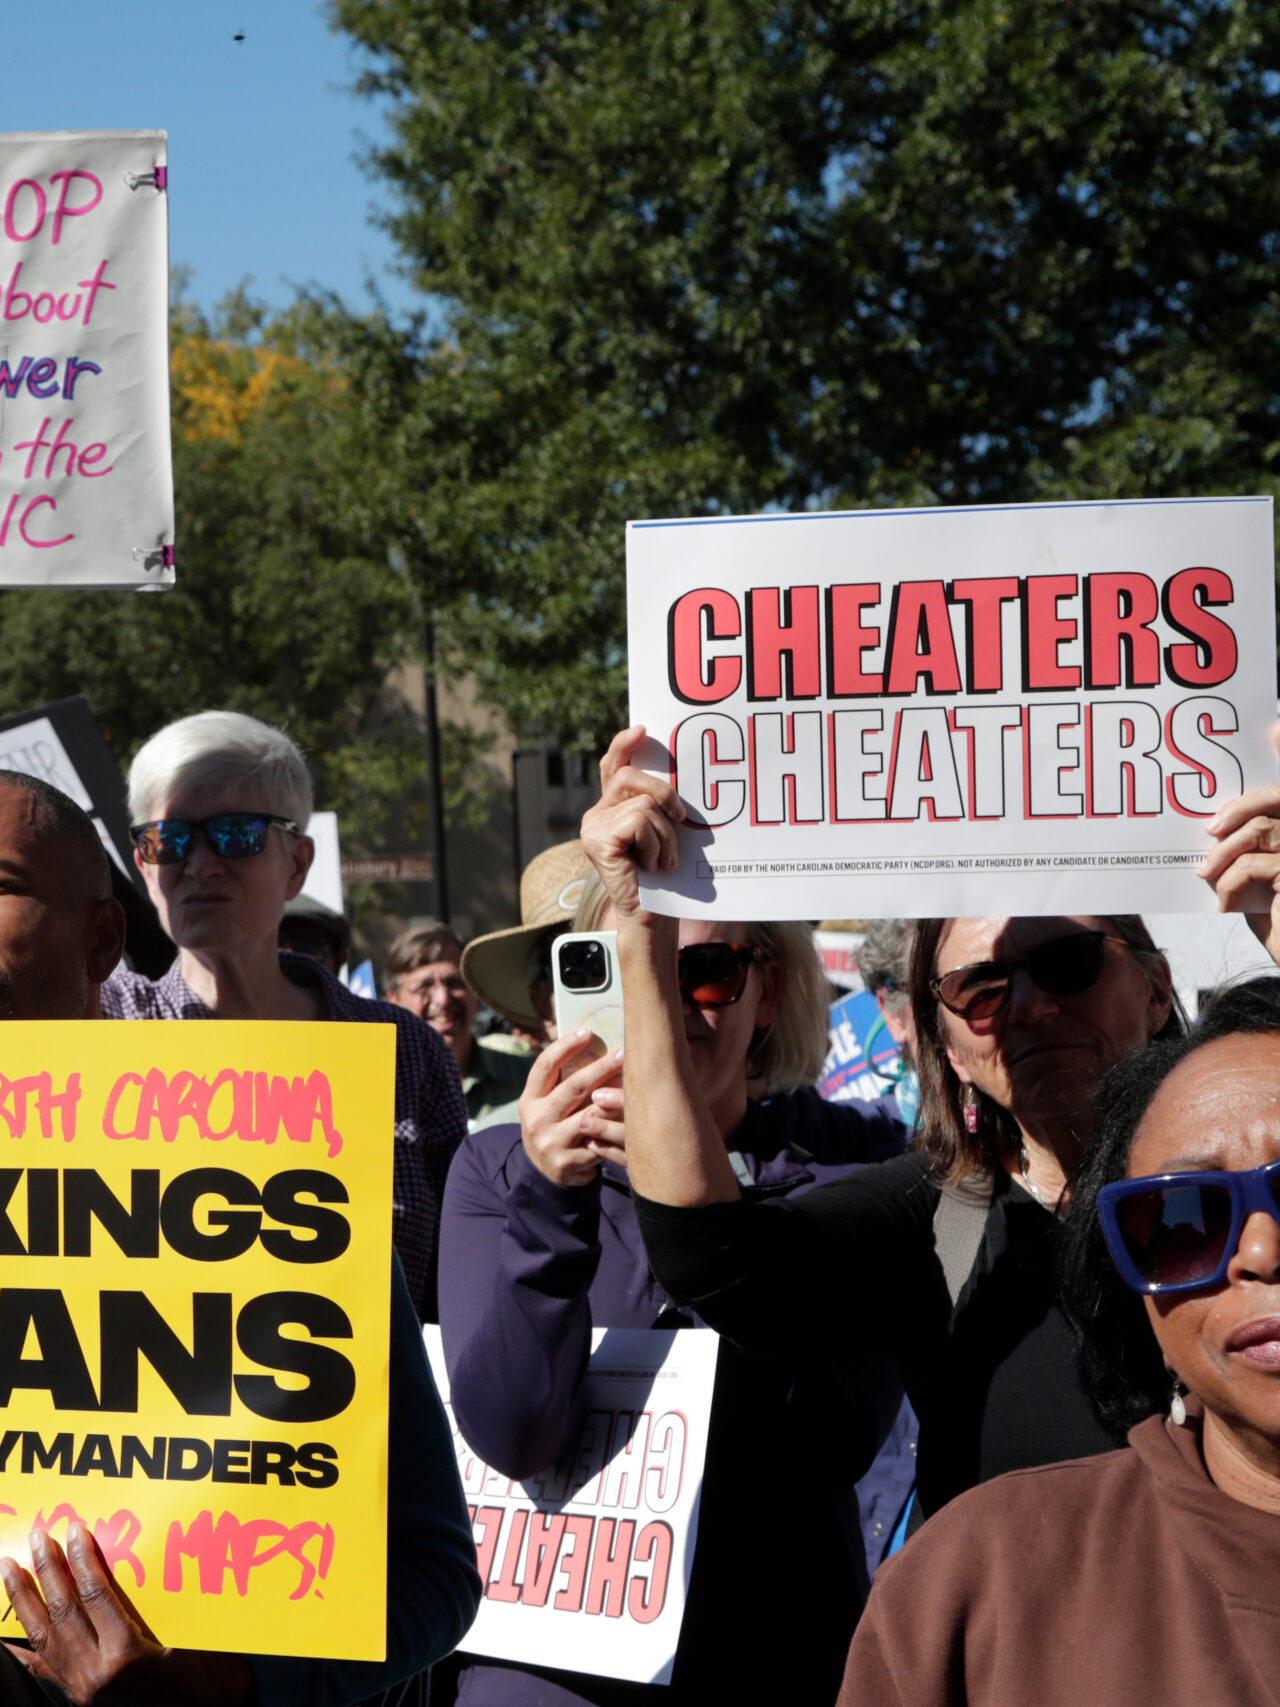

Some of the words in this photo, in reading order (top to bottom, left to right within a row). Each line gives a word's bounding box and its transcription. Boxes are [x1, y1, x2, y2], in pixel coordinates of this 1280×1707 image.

[13, 418, 113, 478] the
[667, 567, 1238, 706] CHEATERS
[670, 695, 1245, 830] CHEATERS
[709, 865, 727, 874] PAID
[728, 865, 742, 873] FOR
[744, 864, 754, 873] BY
[756, 864, 769, 873] THE
[770, 863, 795, 872] NORTH
[797, 862, 833, 872] CAROLINA
[835, 861, 883, 871] DEMOCRATIC
[884, 860, 908, 870] PARTY
[958, 859, 973, 868] NOT
[975, 858, 1022, 868] AUTHORIZED
[1023, 857, 1033, 867] BY
[1036, 857, 1051, 867] ANY
[1053, 856, 1096, 866] CANDIDATE
[1098, 856, 1109, 865] OR
[1110, 855, 1161, 865] CANDIDATE'S
[1162, 854, 1208, 864] COMMITTE
[163, 1510, 335, 1600] MAPS!
[468, 1504, 674, 1624] CHEATE
